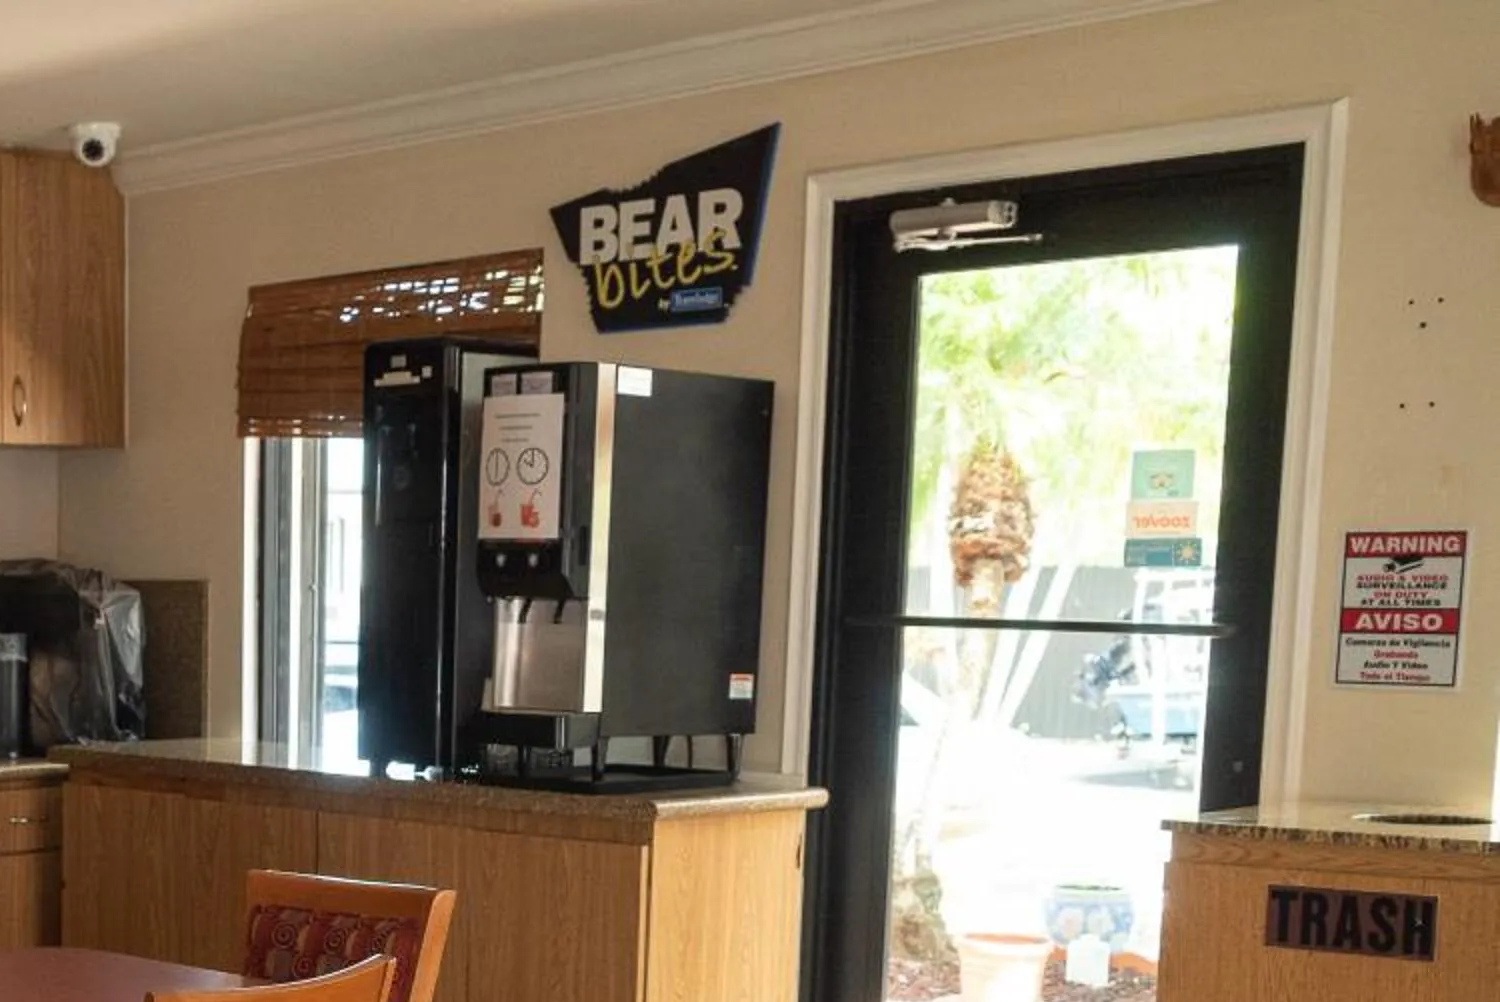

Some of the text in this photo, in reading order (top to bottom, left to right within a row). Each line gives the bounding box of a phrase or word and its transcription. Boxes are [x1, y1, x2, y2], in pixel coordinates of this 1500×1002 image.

[580, 188, 743, 266] BEAR
[594, 229, 735, 309] bites
[1350, 535, 1460, 553] WARNING
[1355, 613, 1443, 631] AVISO
[1271, 889, 1434, 955] TRASH
